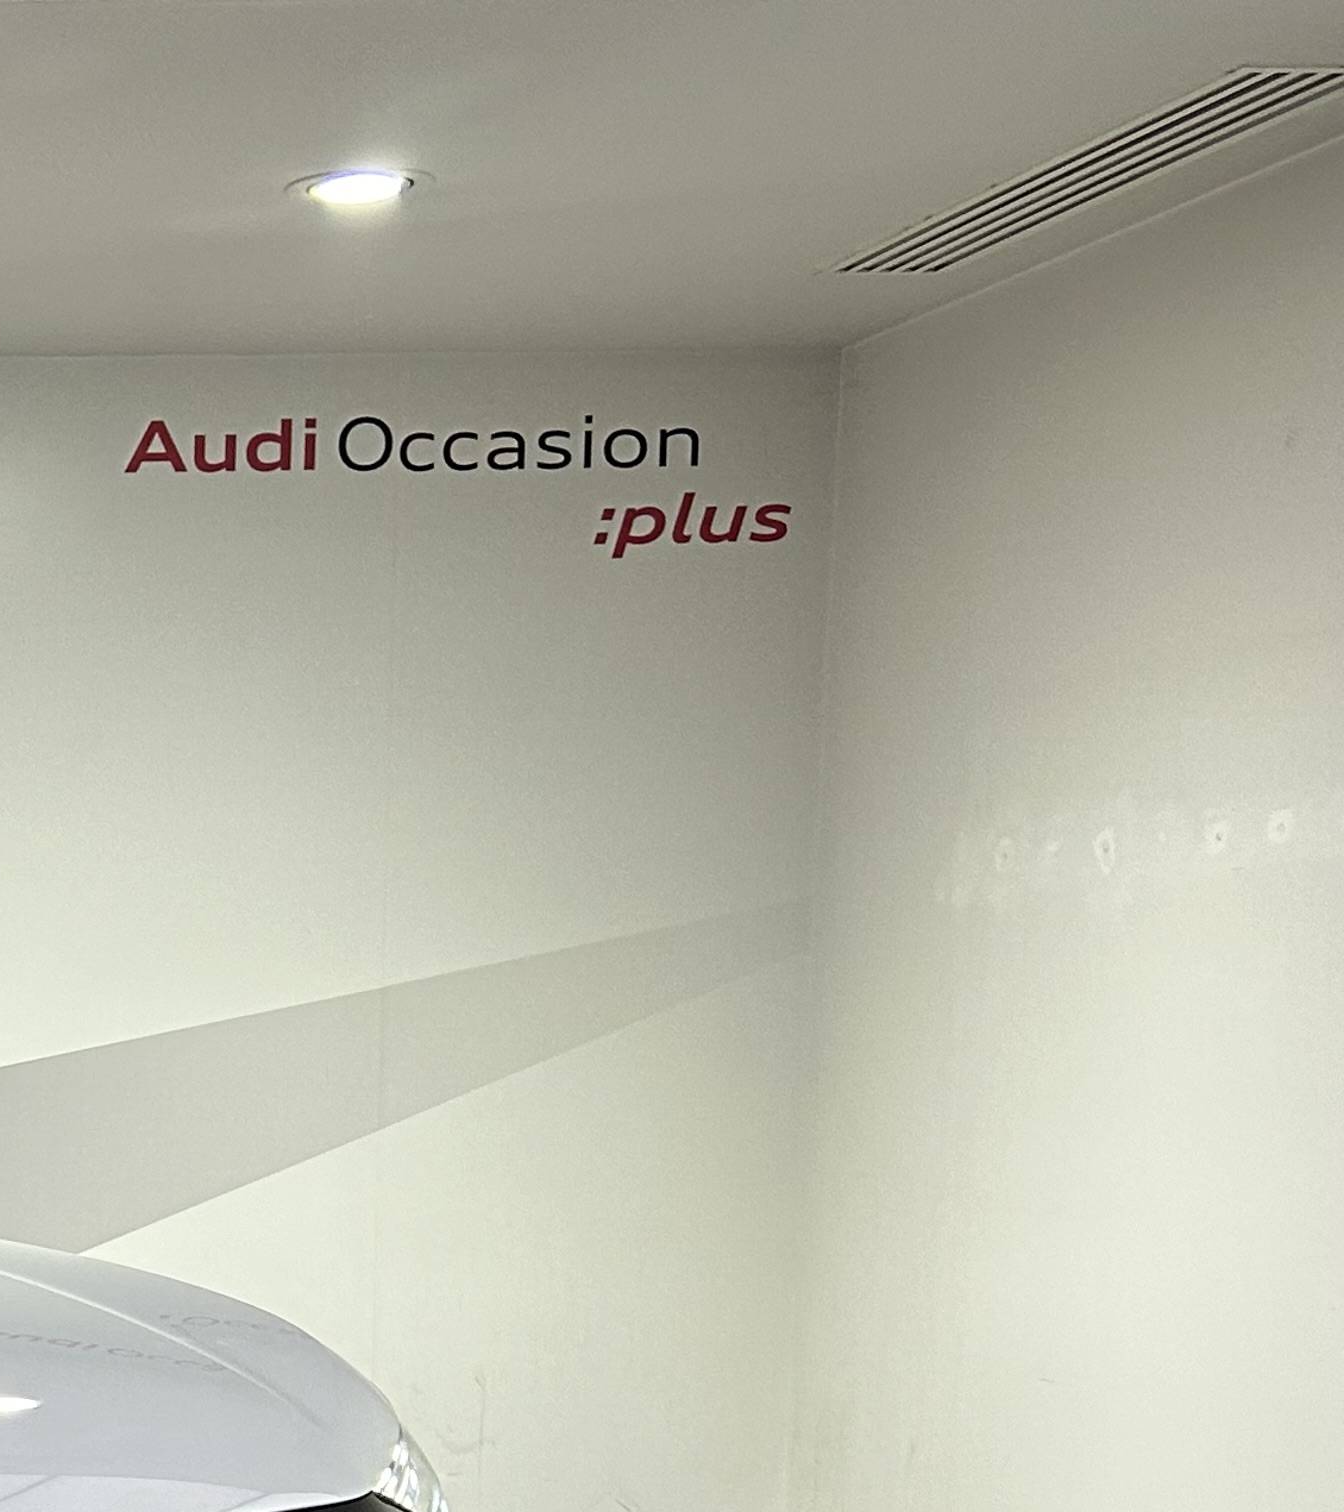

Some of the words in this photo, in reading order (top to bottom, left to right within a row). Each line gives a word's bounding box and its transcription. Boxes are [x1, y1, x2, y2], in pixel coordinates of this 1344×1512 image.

[124, 417, 318, 474] Audi
[338, 415, 701, 472] Occasion
[593, 492, 792, 559] :plus
